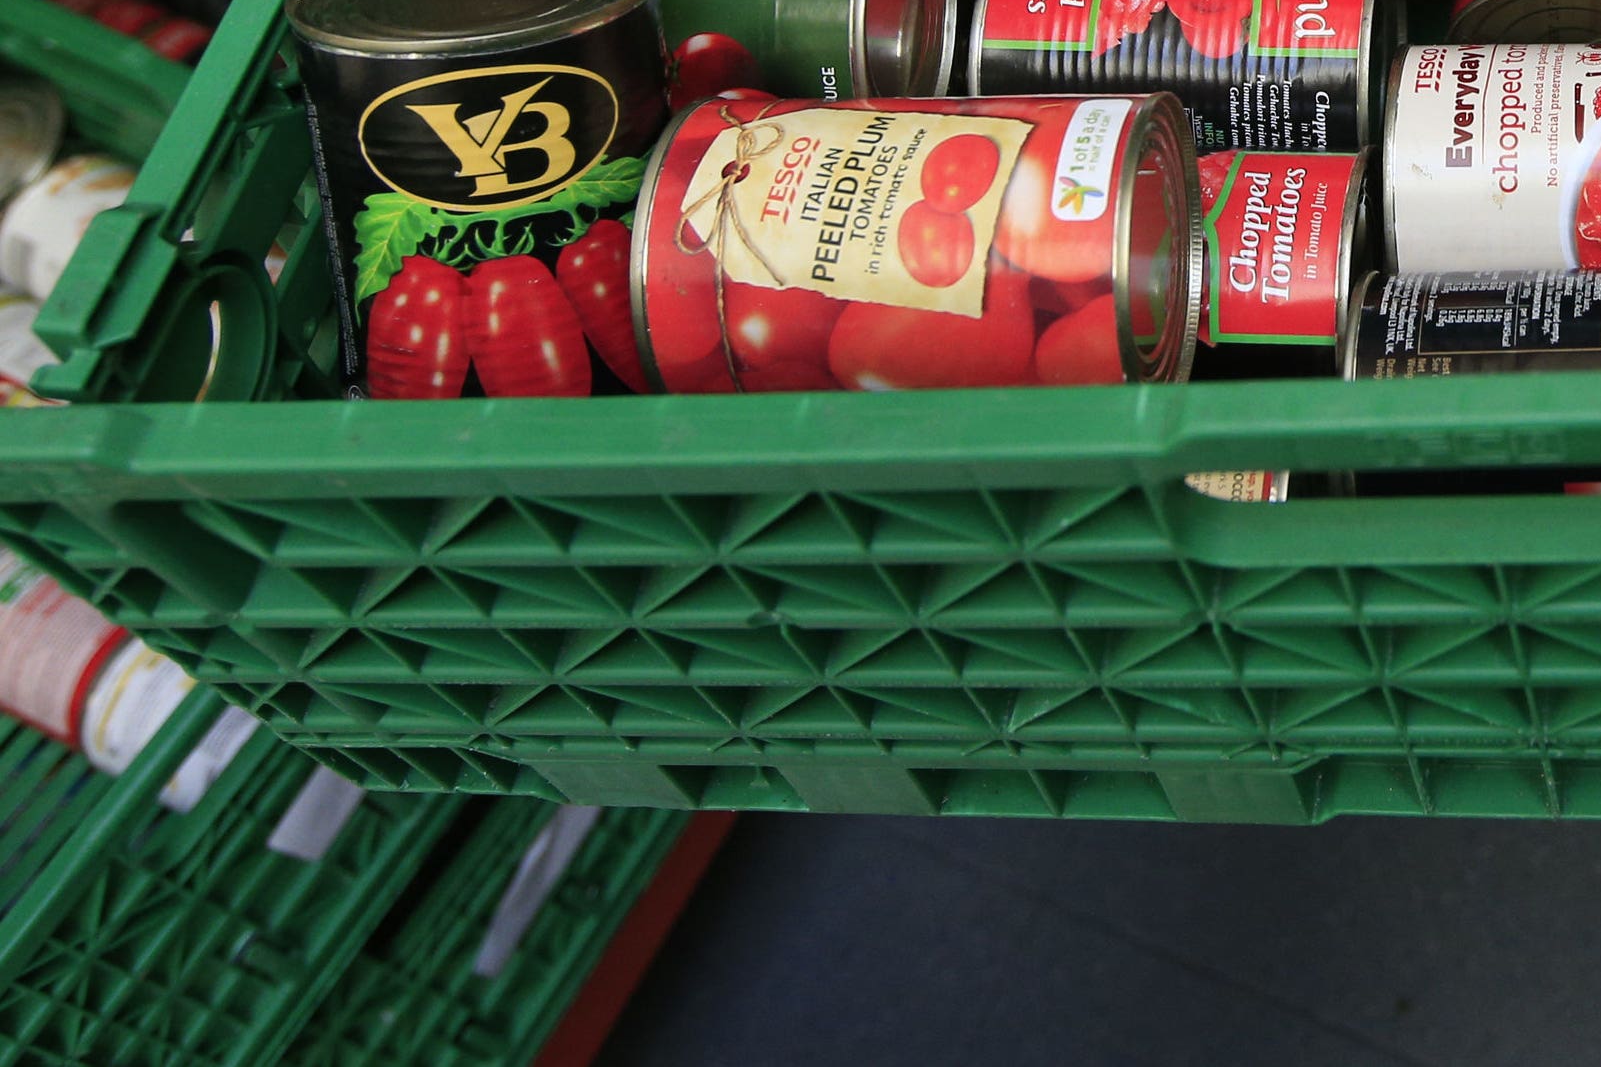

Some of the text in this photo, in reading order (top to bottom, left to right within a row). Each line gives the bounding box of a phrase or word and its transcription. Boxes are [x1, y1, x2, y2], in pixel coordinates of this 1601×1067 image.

[1256, 74, 1266, 121] Pomodori
[1283, 80, 1292, 119] Tomates
[1415, 49, 1439, 92] TESCO
[1531, 66, 1545, 133] Produced and
[1084, 108, 1105, 124] day
[1230, 87, 1239, 127] Gehakte
[1243, 82, 1252, 120] Tomates
[1301, 123, 1309, 131] in
[1446, 53, 1485, 167] Everyday
[1492, 68, 1526, 193] chopped
[1072, 148, 1088, 161] of
[1076, 136, 1090, 144] 5
[1547, 113, 1559, 164] artificial
[760, 137, 812, 222] TESCO
[800, 148, 843, 221] ITALIAN
[811, 116, 896, 282] PEELED PLUM
[849, 146, 898, 240] TOMATOES
[864, 129, 928, 274] in rich tomato sauce
[1547, 168, 1558, 187] No
[1229, 172, 1273, 293] Chopped
[1261, 168, 1307, 304] Tomatoes
[1303, 182, 1328, 280] in Tomato Juice
